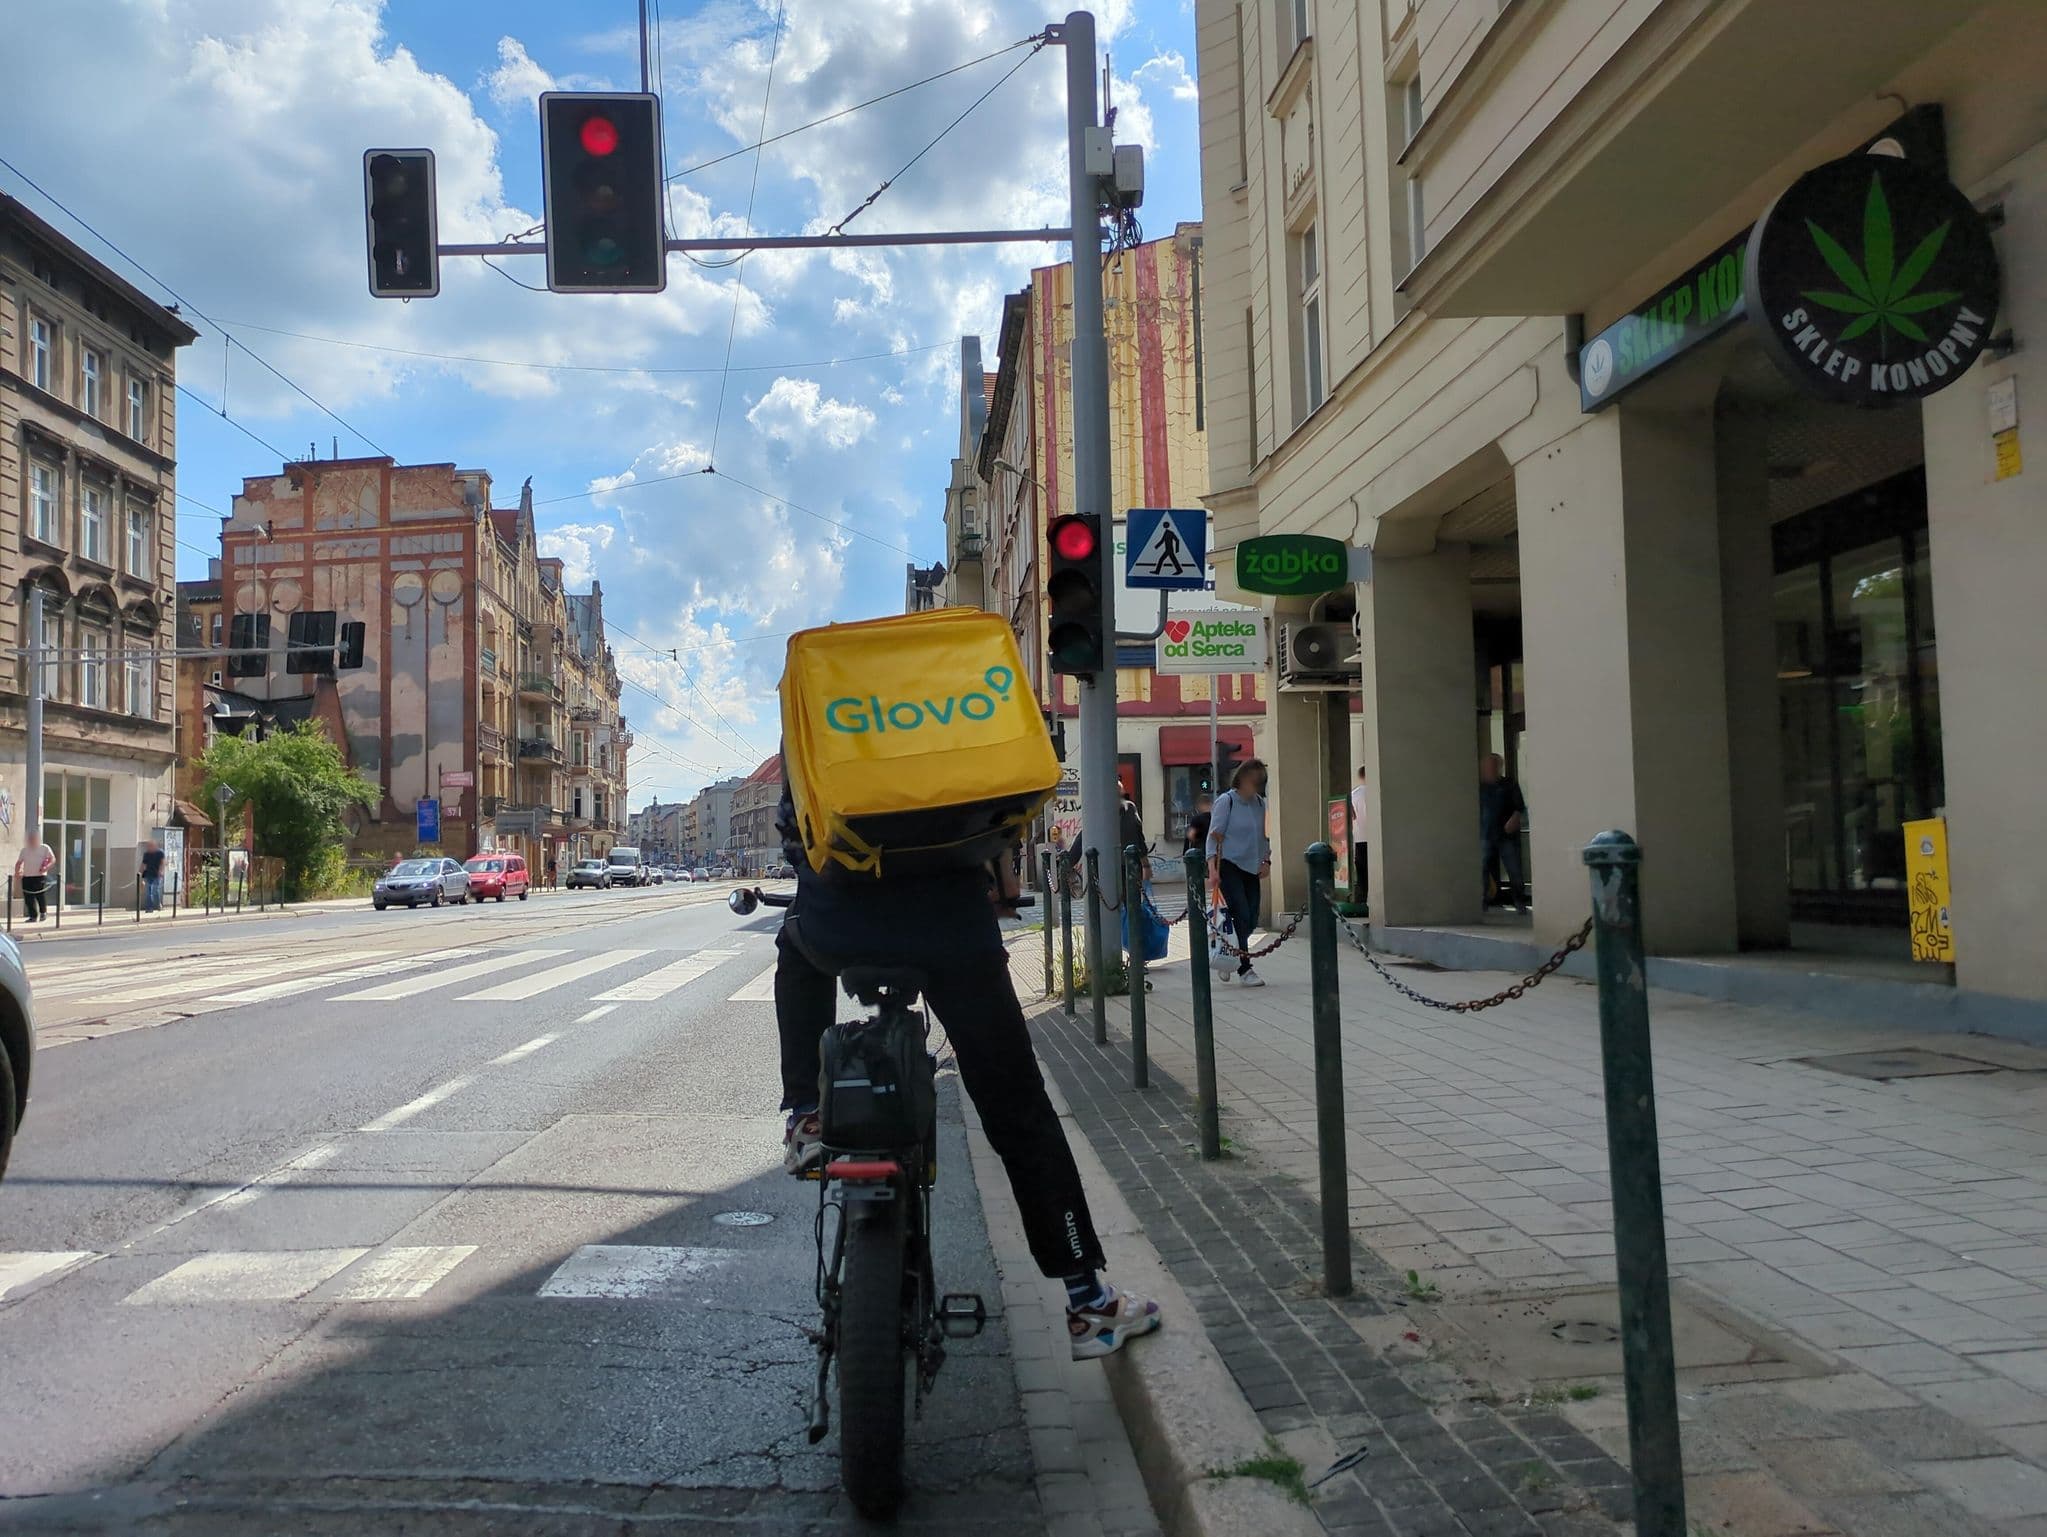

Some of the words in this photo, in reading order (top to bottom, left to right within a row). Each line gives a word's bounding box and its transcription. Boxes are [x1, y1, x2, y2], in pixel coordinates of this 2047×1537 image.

[1617, 284, 1692, 376] SKLEP
[1782, 307, 1861, 383] SKLEP
[1870, 306, 1985, 392] KONOPNY
[1245, 547, 1339, 573] żabka
[1164, 641, 1188, 657] od
[1192, 641, 1245, 657] Serca
[1191, 620, 1256, 642] Apteka
[826, 692, 996, 733] Glovo
[1065, 1211, 1083, 1259] umbro
